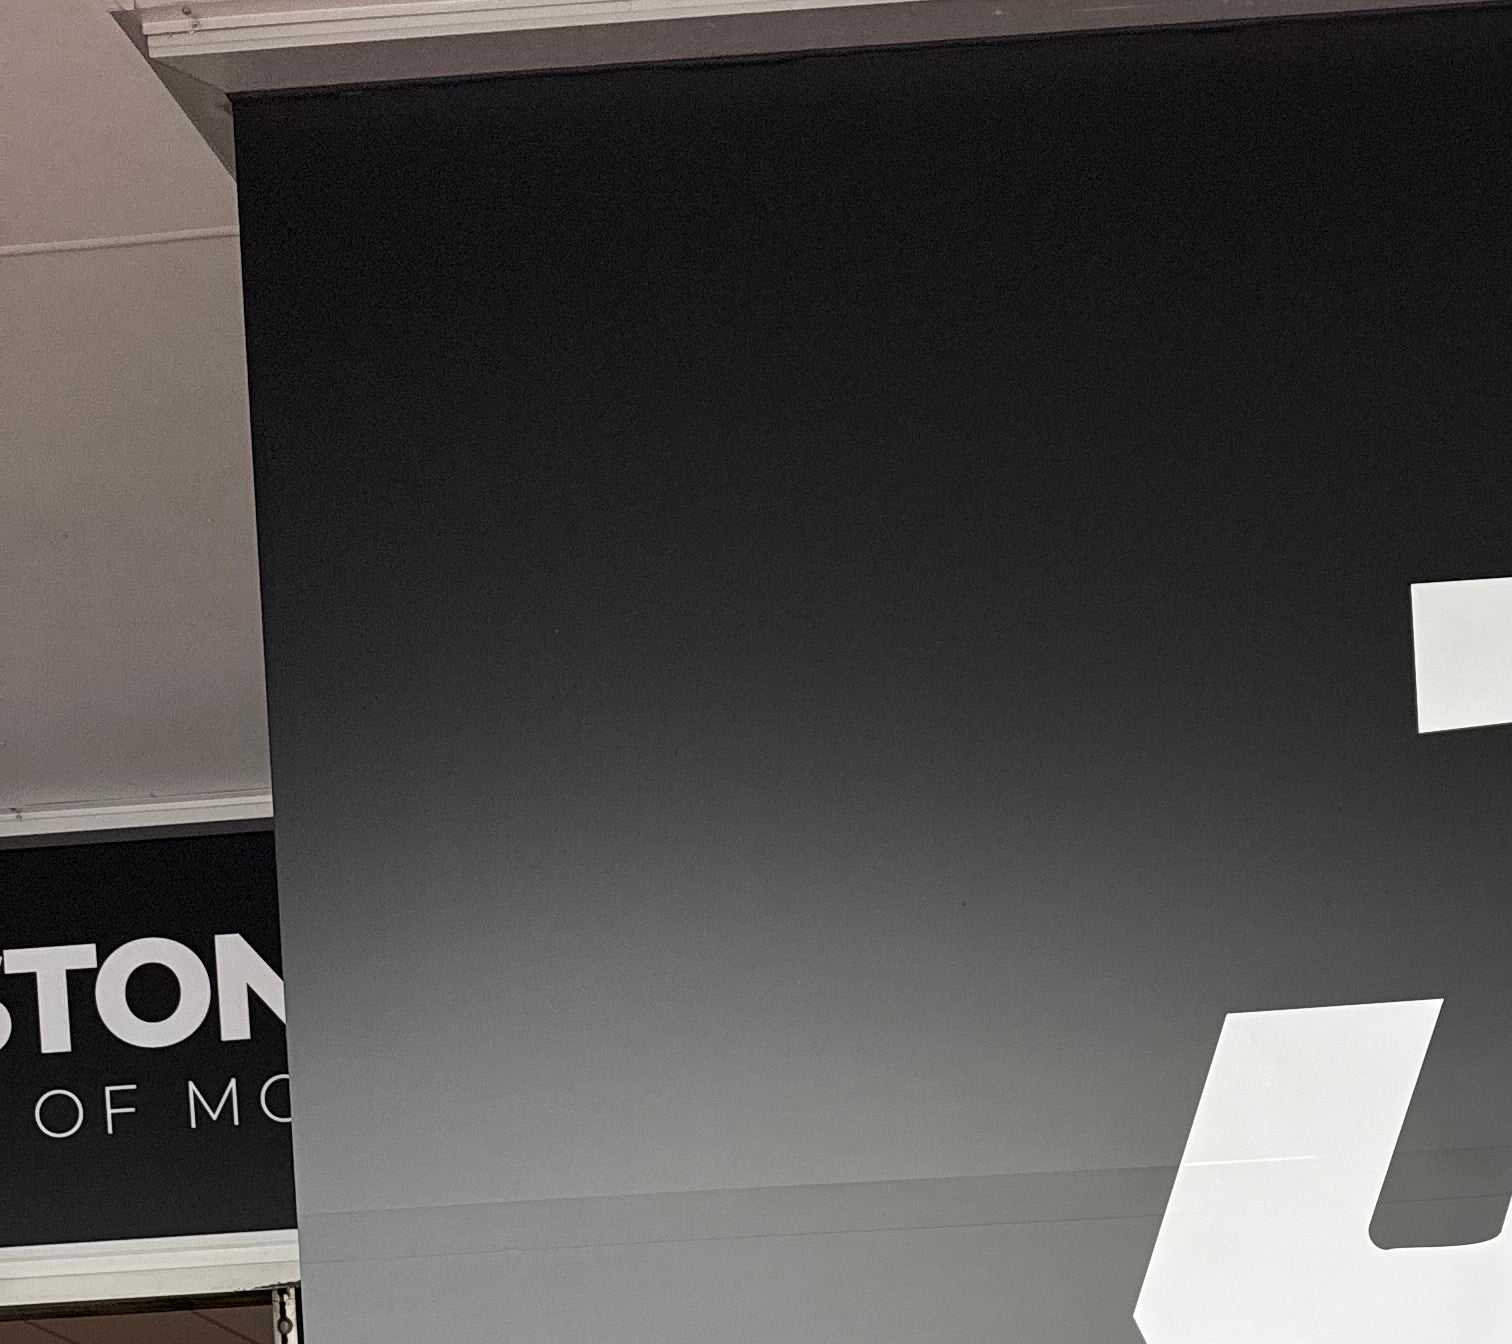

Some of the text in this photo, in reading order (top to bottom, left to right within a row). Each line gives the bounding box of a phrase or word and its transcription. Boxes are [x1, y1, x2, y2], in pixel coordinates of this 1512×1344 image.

[0, 932, 287, 1054] TON
[34, 1073, 293, 1138] OF MO
